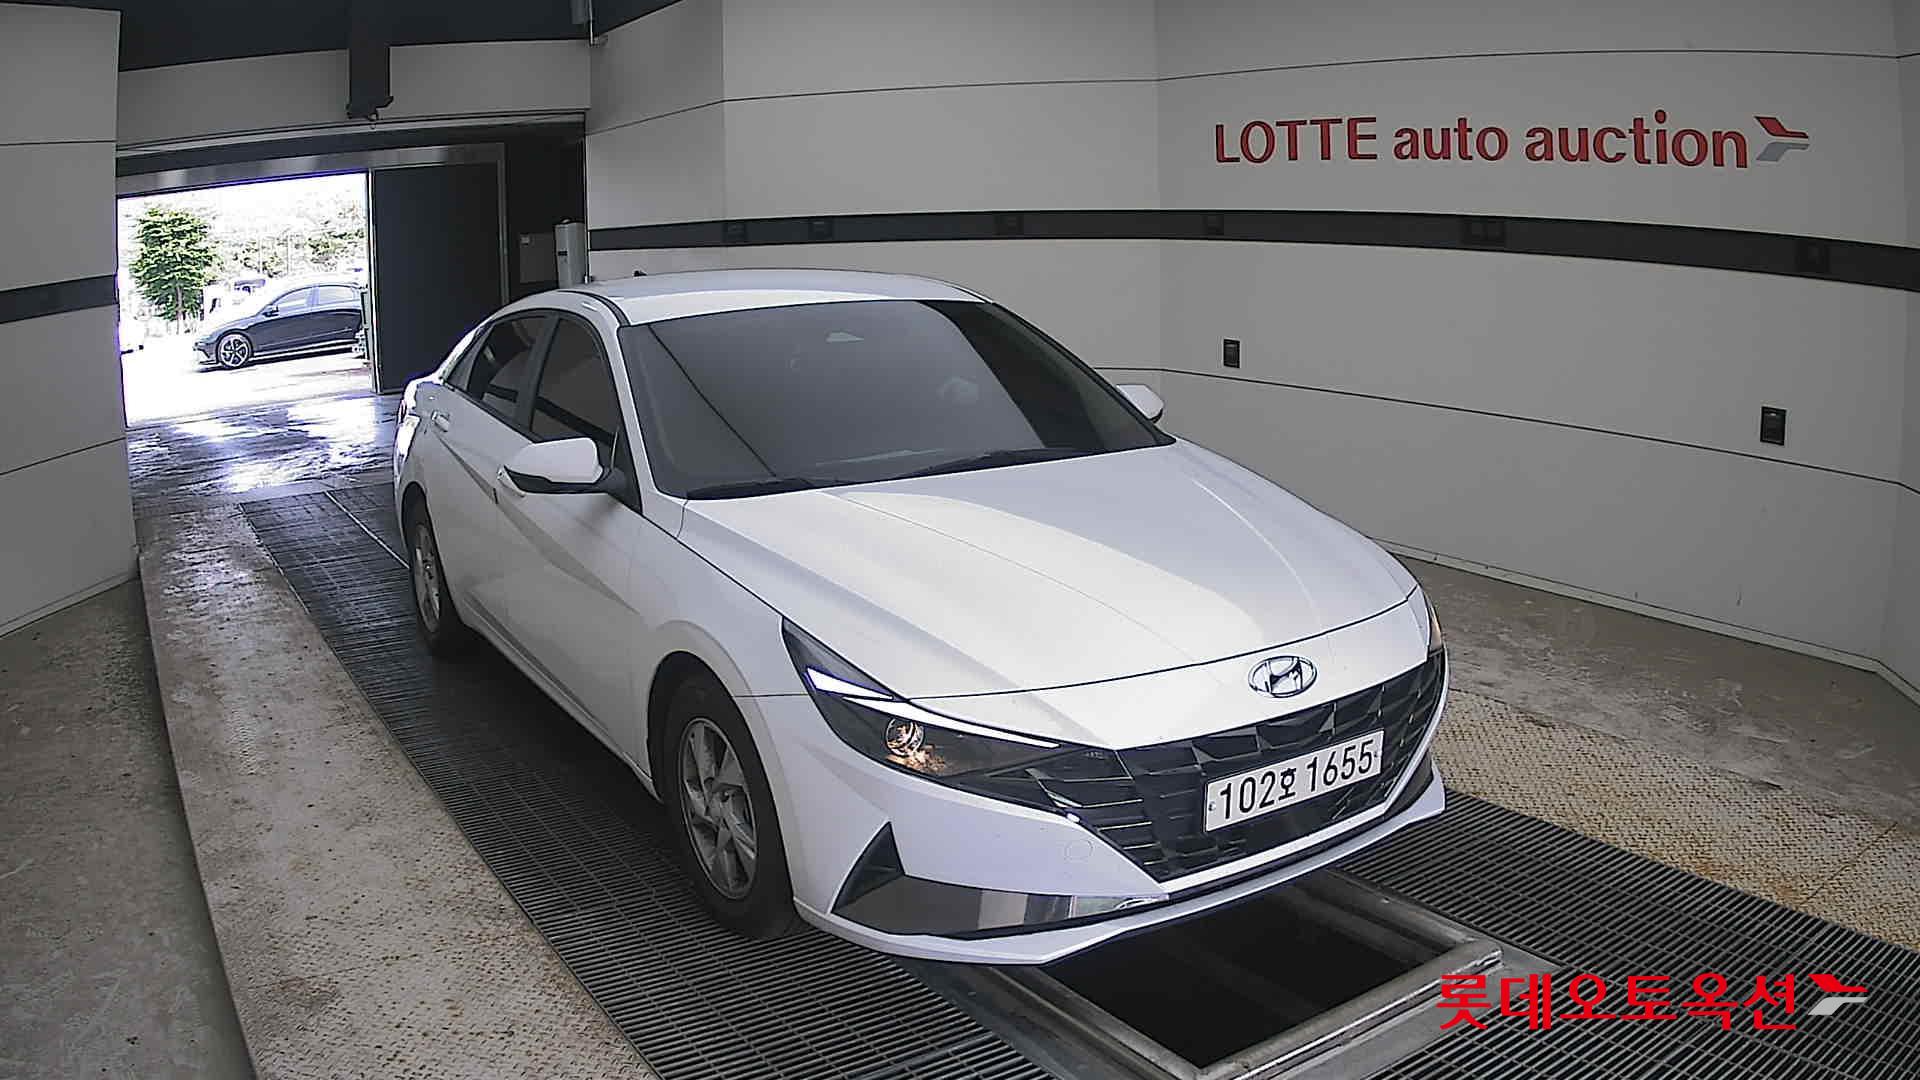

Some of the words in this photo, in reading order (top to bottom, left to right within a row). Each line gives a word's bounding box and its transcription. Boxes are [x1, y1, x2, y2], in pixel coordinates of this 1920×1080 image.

[1215, 116, 1378, 164] LOTTE
[1393, 117, 1509, 162] auto
[1525, 110, 1748, 169] auction
[1220, 767, 1297, 820] 102호
[1305, 739, 1374, 793] 1655
